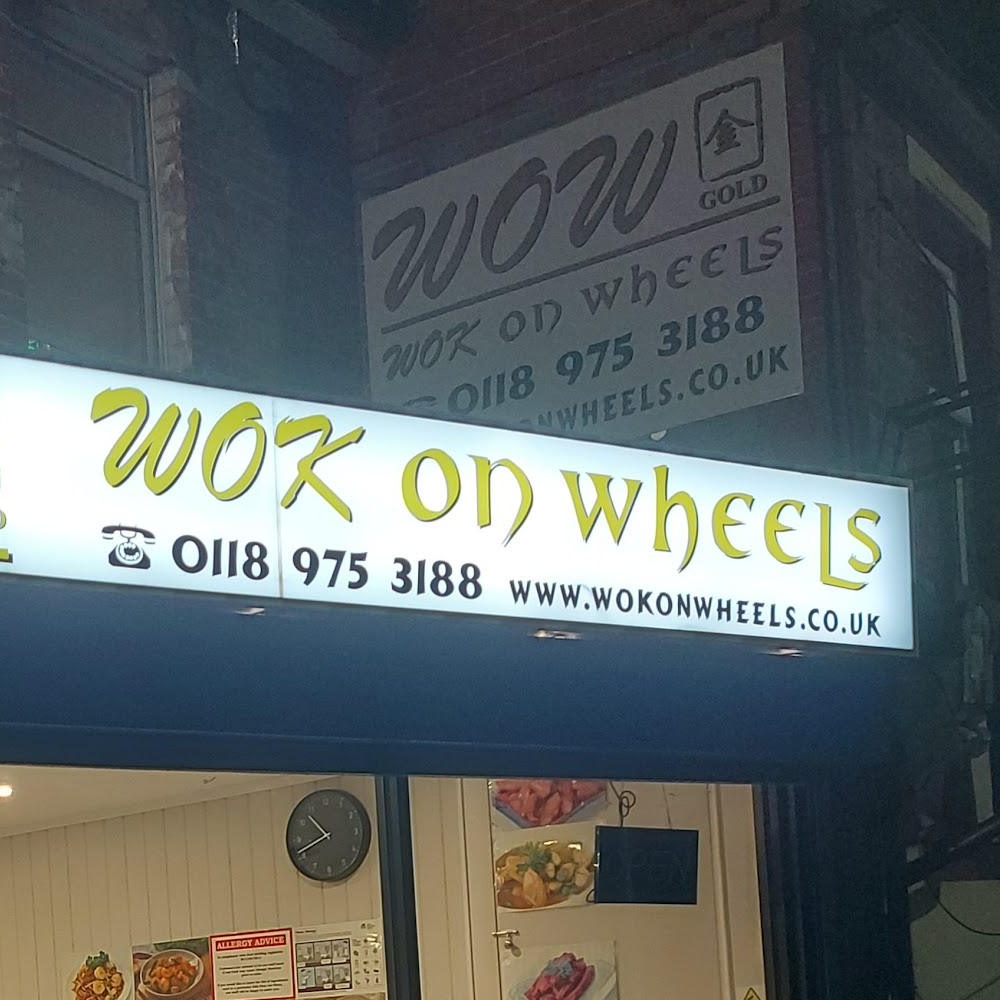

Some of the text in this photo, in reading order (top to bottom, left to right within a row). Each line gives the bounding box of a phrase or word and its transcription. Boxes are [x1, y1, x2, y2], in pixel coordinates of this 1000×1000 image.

[703, 108, 754, 155] 金
[372, 120, 678, 312] WOW
[698, 174, 768, 210] GOLD
[382, 318, 481, 380] WOK
[447, 295, 765, 416] 0118 975 3188
[520, 345, 789, 431] NWHEELS.CO.UK
[91, 386, 366, 522] WOK
[172, 534, 483, 599] 0118 975 3188
[509, 579, 882, 638] WWW.WOKONWHEELS.CO.UK
[217, 936, 285, 950] ALLERGY ADVICE
